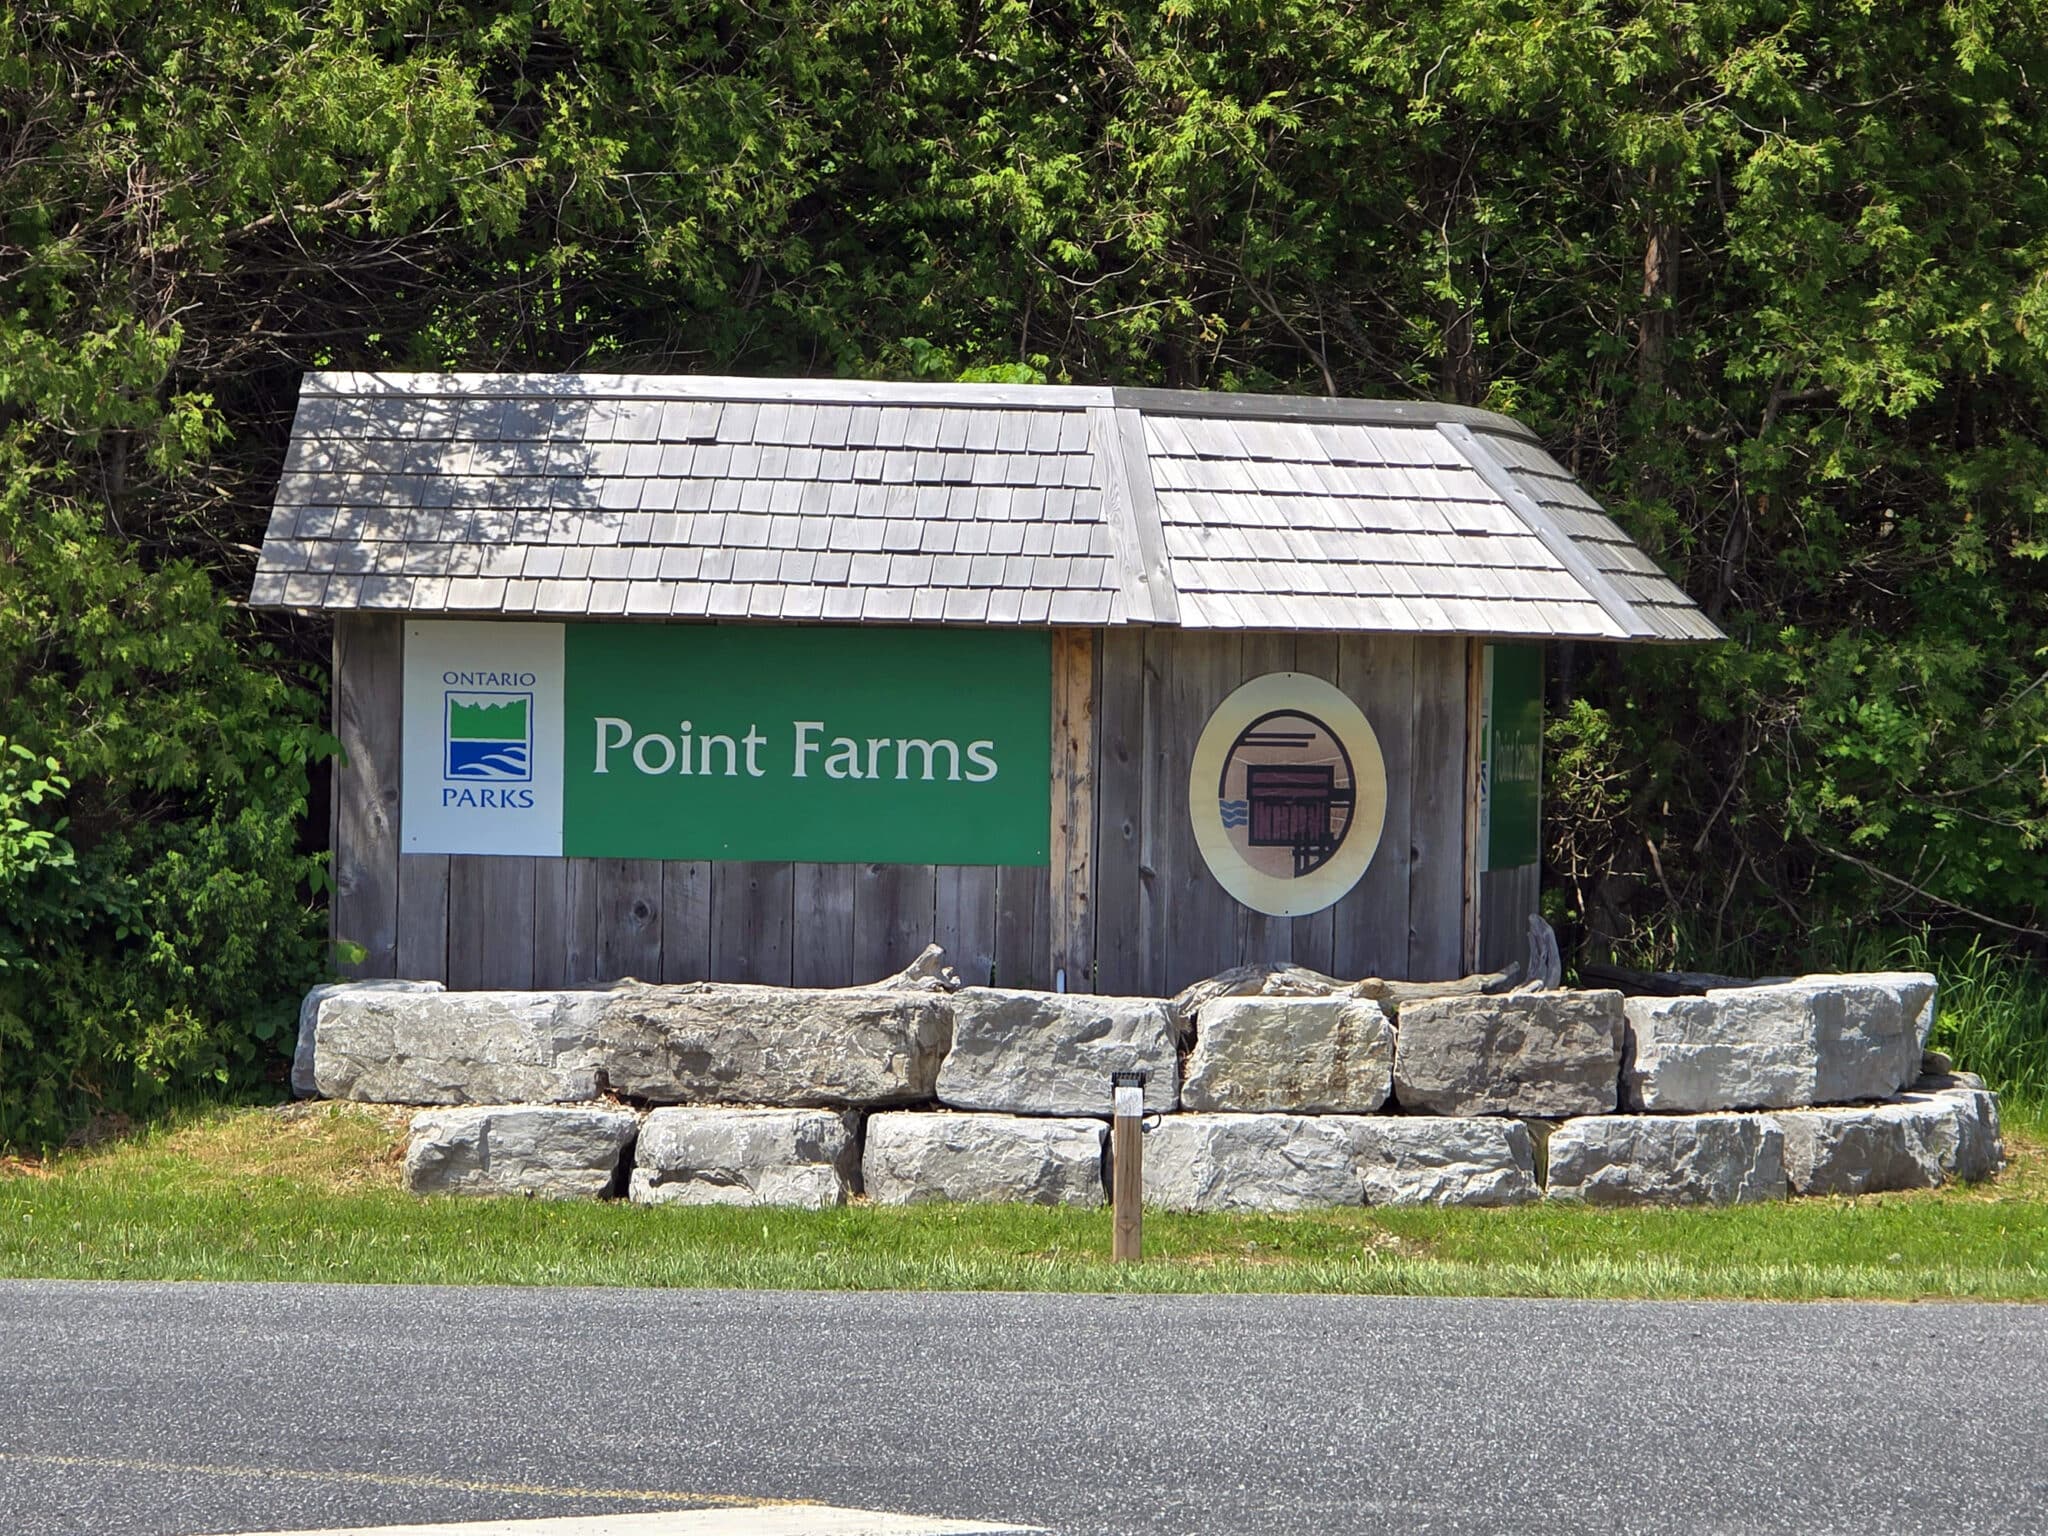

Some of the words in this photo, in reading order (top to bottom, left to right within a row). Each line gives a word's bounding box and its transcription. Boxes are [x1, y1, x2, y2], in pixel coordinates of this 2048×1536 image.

[442, 671, 536, 687] ONTARIO
[593, 717, 767, 777] Point
[792, 721, 998, 782] Farms
[442, 788, 535, 809] PARKS
